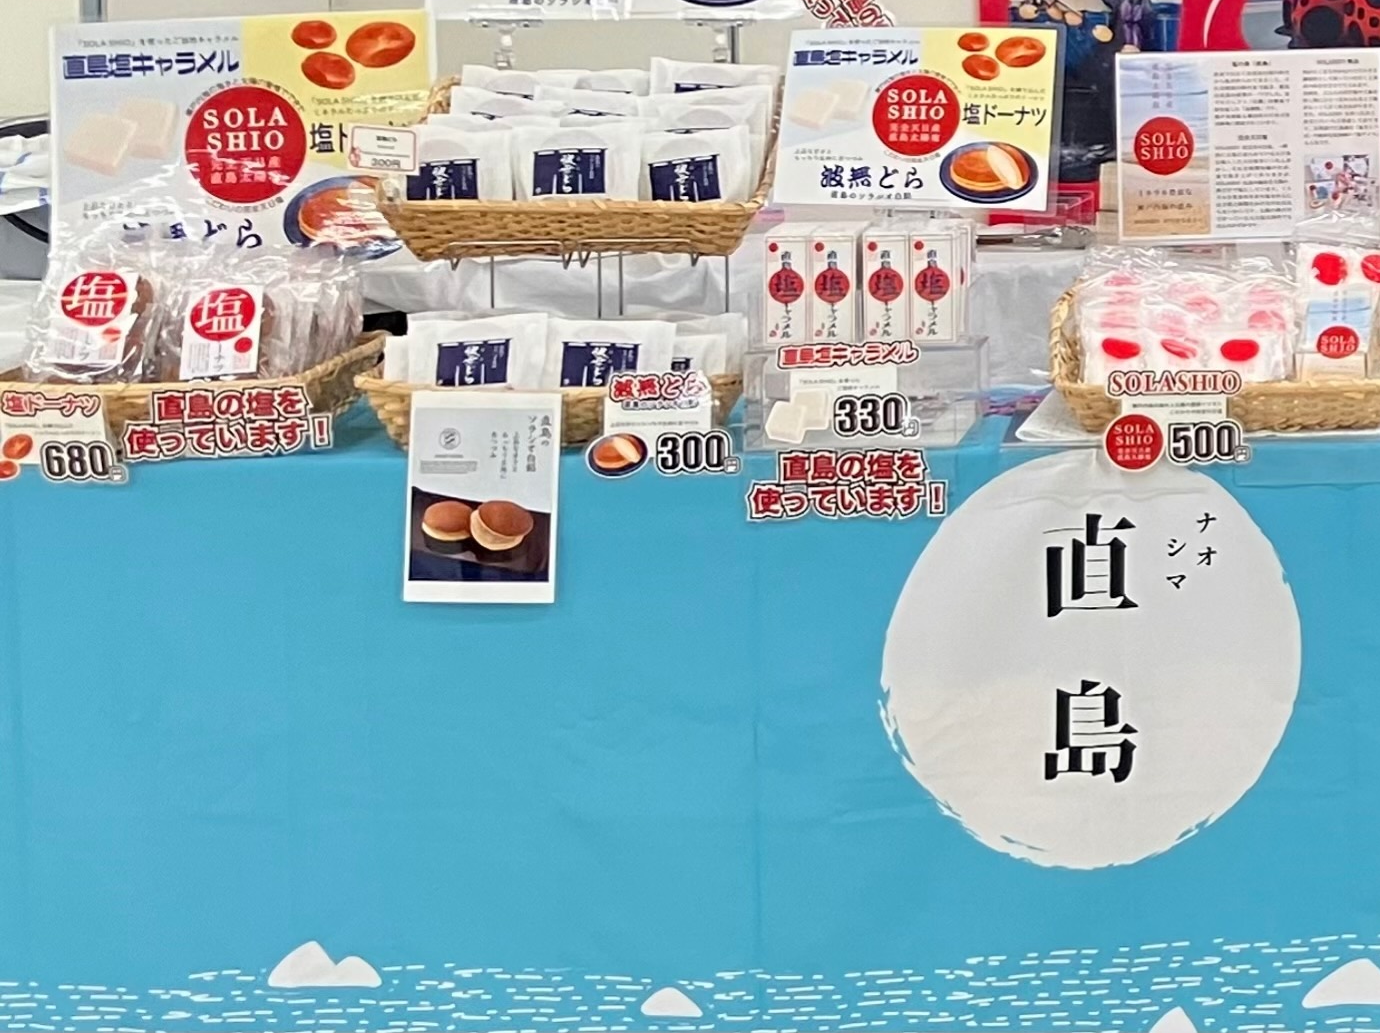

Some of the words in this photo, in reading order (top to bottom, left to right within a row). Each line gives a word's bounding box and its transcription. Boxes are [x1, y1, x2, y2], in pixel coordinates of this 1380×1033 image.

[62, 50, 240, 79] 直島塩キャラメル
[887, 89, 948, 104] SOLA
[203, 106, 288, 129] SOLA
[887, 105, 945, 120] SHIO
[962, 102, 1047, 126] 塩ドーナツ
[207, 130, 285, 152] SHIO
[1140, 132, 1189, 146] SOLA
[1140, 146, 1189, 160] SHIO
[820, 164, 923, 190] 波無どら
[65, 275, 122, 319] 塩
[195, 292, 248, 334] 塩
[1320, 334, 1356, 344] SOLA
[1111, 373, 1238, 393] SOLASHIO
[4, 393, 98, 415] 塩ドーナツ
[156, 390, 303, 419] 直島の塩を
[127, 420, 330, 456] 使っています！
[1113, 423, 1154, 435] SOLA
[1115, 435, 1154, 446] SHIO
[782, 451, 924, 482] 直島の塩を
[752, 486, 945, 517] 使っています！
[1196, 512, 1217, 567] ナオ
[1166, 537, 1188, 590] シマ
[1043, 513, 1139, 783] 直島
